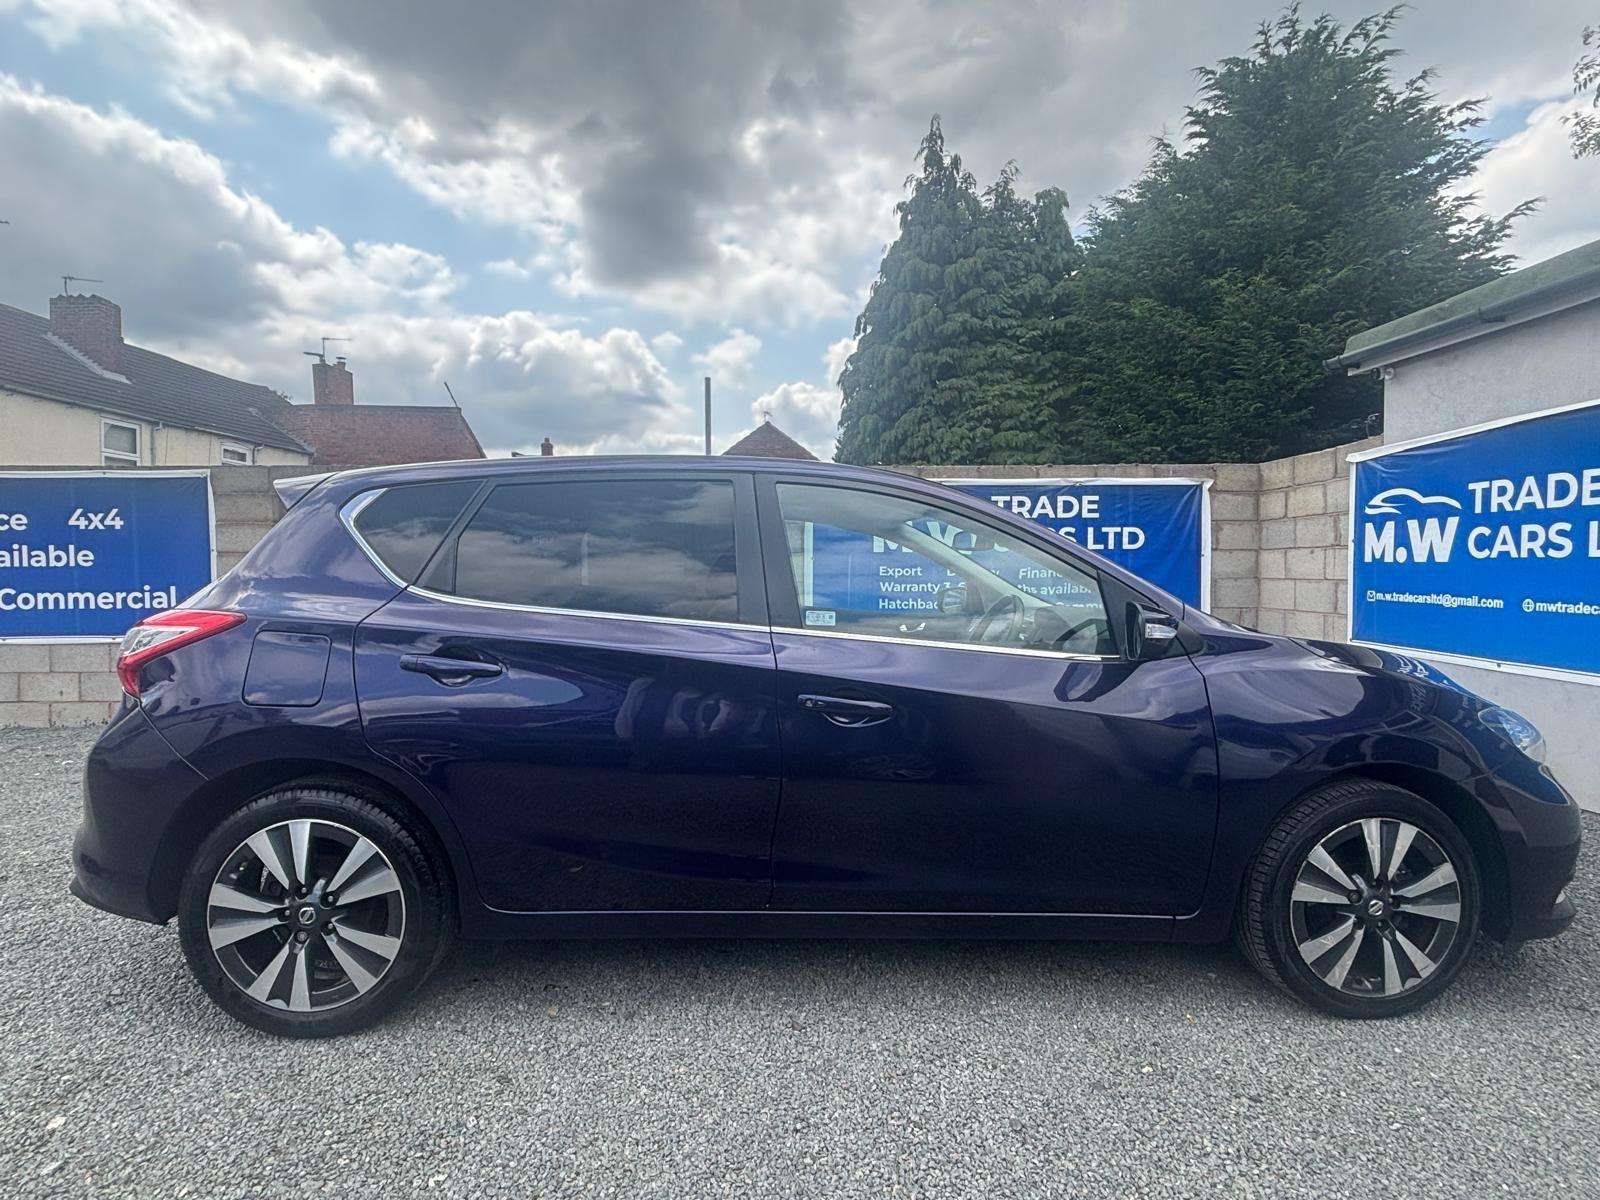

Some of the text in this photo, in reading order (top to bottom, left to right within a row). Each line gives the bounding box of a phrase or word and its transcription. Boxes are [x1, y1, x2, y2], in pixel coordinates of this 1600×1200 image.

[1468, 468, 1600, 514] TRADE
[68, 508, 124, 529] 4x4
[991, 495, 1100, 519] TRADE
[1087, 526, 1146, 550] LTD
[1364, 516, 1460, 563] M.W
[1467, 522, 1573, 559] CARS
[879, 566, 923, 578] Export
[0, 585, 176, 610] Commercial
[880, 581, 940, 594] Warranty
[1376, 592, 1504, 609] m.w.tradecarsltd@gmail.com
